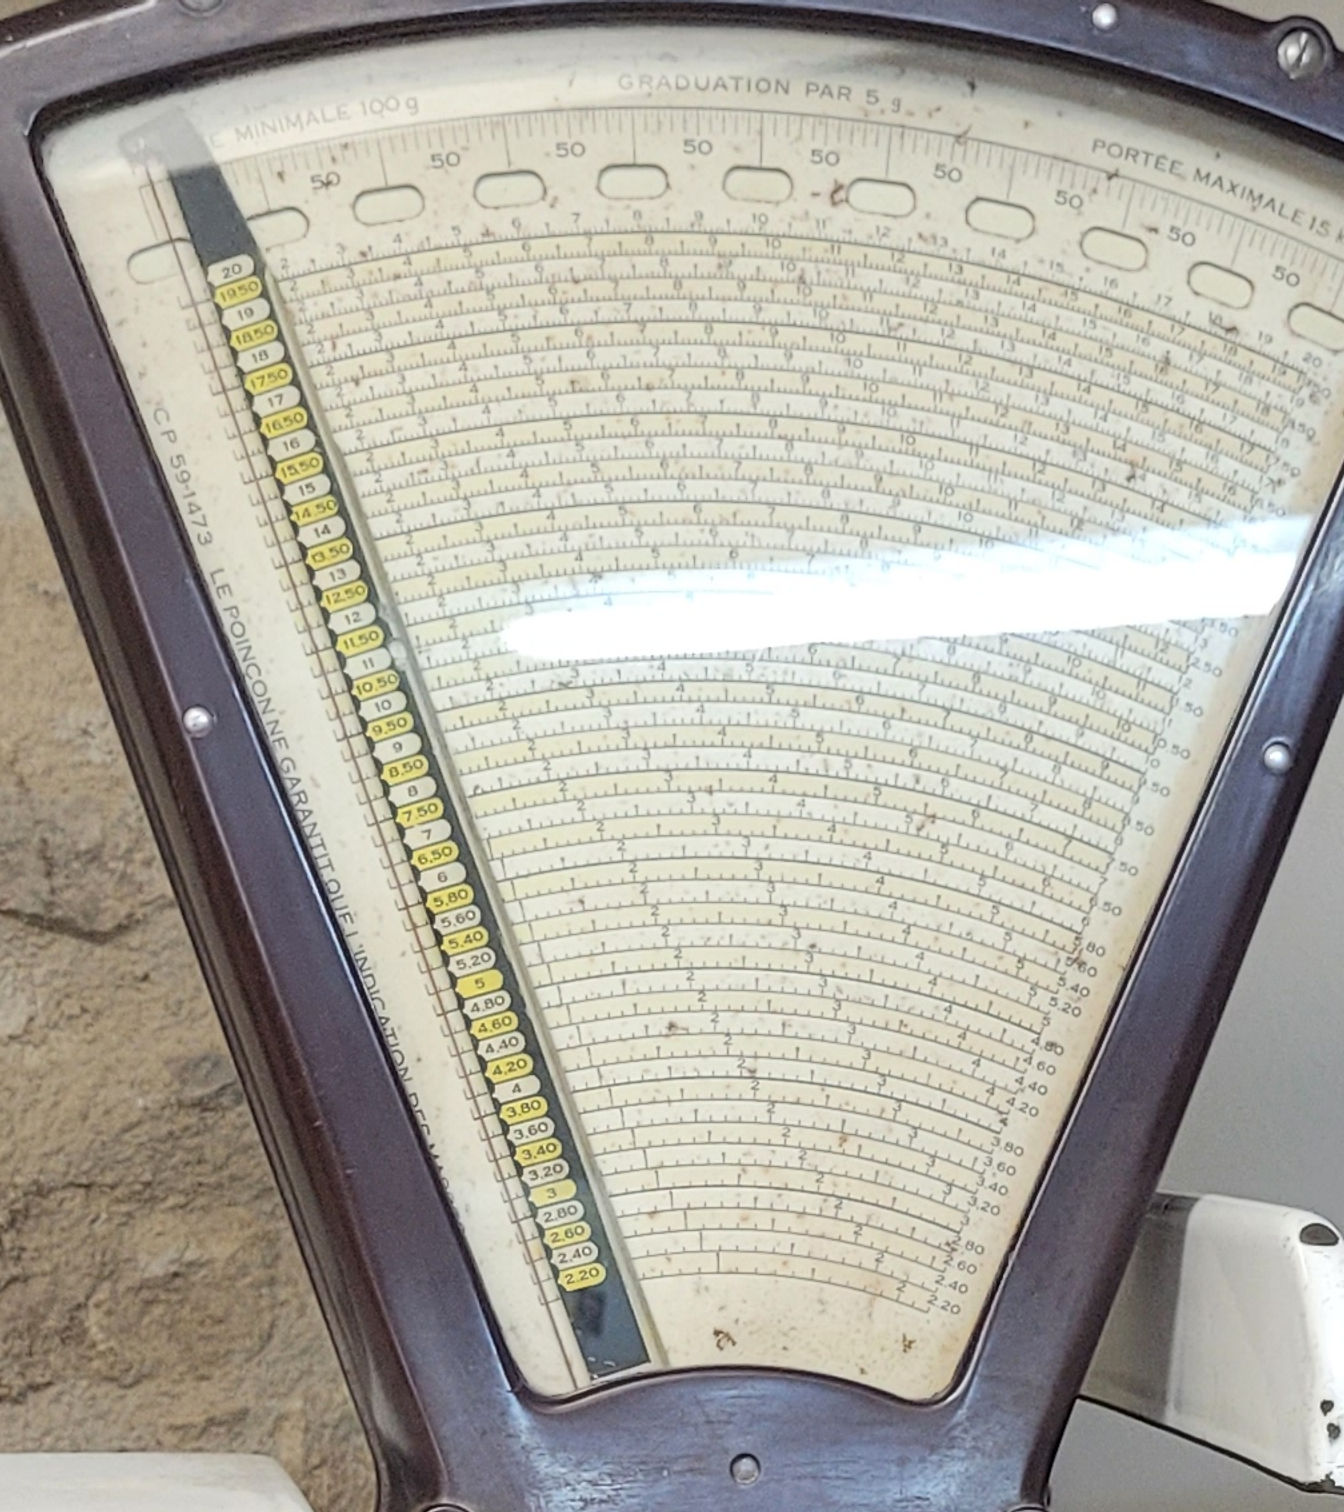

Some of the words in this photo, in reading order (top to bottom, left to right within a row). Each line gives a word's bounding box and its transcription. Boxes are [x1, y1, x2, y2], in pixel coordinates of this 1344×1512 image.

[617, 72, 791, 96] GRADUATION
[805, 81, 852, 102] PAR
[865, 89, 879, 106] 5
[891, 95, 902, 113] g
[233, 102, 352, 144] MINIMALE
[360, 96, 401, 116] 100
[406, 95, 420, 115] g
[1192, 167, 1306, 227] MAXIMALE
[1309, 216, 1331, 237] 15
[310, 171, 341, 191] 50
[430, 151, 461, 169] 50
[555, 141, 586, 158] 50
[682, 139, 713, 156] 50
[810, 149, 840, 167] 50
[933, 162, 963, 183] 50
[1054, 189, 1084, 210] 50
[1167, 226, 1196, 247] 50
[1272, 265, 1300, 287] 50
[222, 263, 243, 280] 20
[238, 307, 255, 322] 19
[251, 349, 270, 363] 18
[267, 393, 285, 408] 17
[153, 406, 170, 426] C
[160, 429, 177, 445] P
[283, 437, 300, 452] 16
[298, 482, 316, 496] 15
[313, 524, 331, 539] 14
[329, 567, 348, 582] 13
[210, 568, 233, 600] LE
[344, 611, 361, 625] 12
[362, 656, 375, 669] 11
[375, 699, 392, 712] 10
[392, 741, 404, 753] 9
[407, 785, 419, 797] 8
[280, 757, 335, 873] GARANTIT
[421, 829, 433, 841] 7
[437, 871, 448, 883] 6
[1099, 875, 1109, 886] 7
[1081, 916, 1090, 926] 6
[474, 978, 485, 990] 5
[1041, 1016, 1051, 1027] 5
[512, 1083, 522, 1094] 4
[546, 1188, 557, 1199] 3
[960, 1214, 970, 1226] 3
